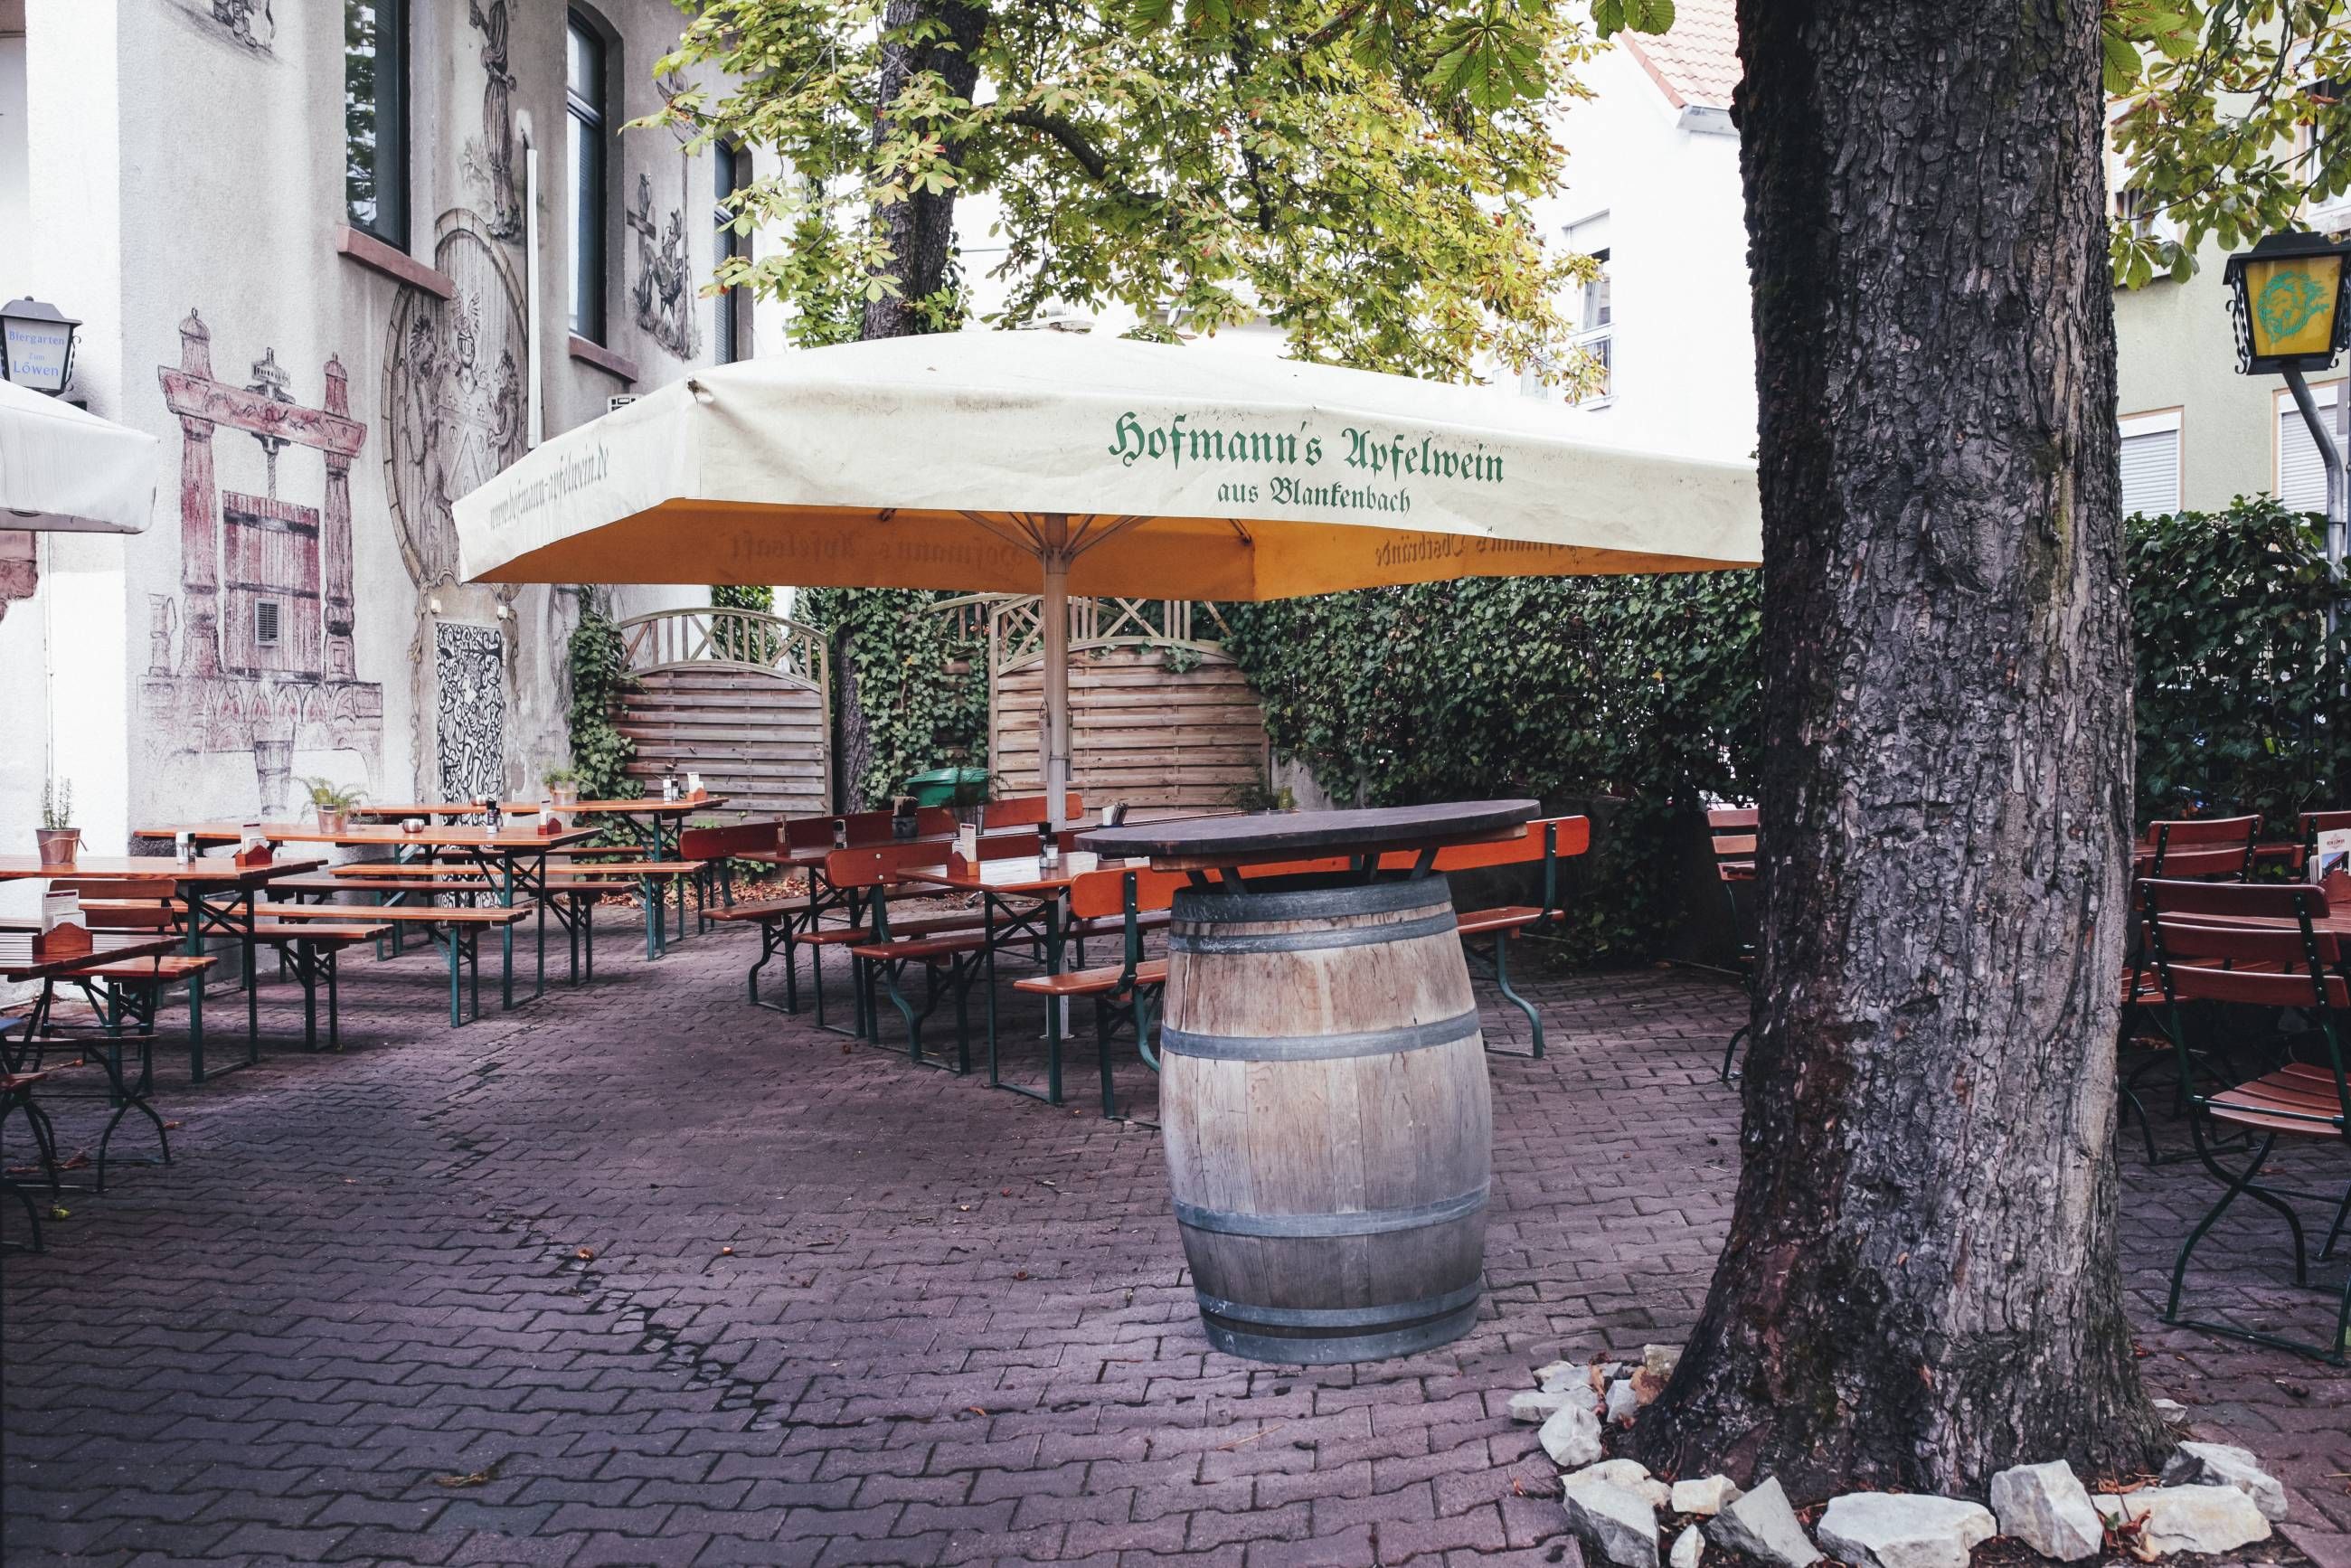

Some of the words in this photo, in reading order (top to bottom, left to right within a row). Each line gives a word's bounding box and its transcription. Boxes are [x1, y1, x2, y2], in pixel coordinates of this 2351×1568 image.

[9, 330, 65, 346] Biergarten
[14, 360, 59, 377] Löwen
[1108, 411, 1323, 469] Hofmann's
[1342, 428, 1505, 484] Apfelwein
[1217, 482, 1259, 504] aus
[1270, 477, 1411, 515] Blankenbach
